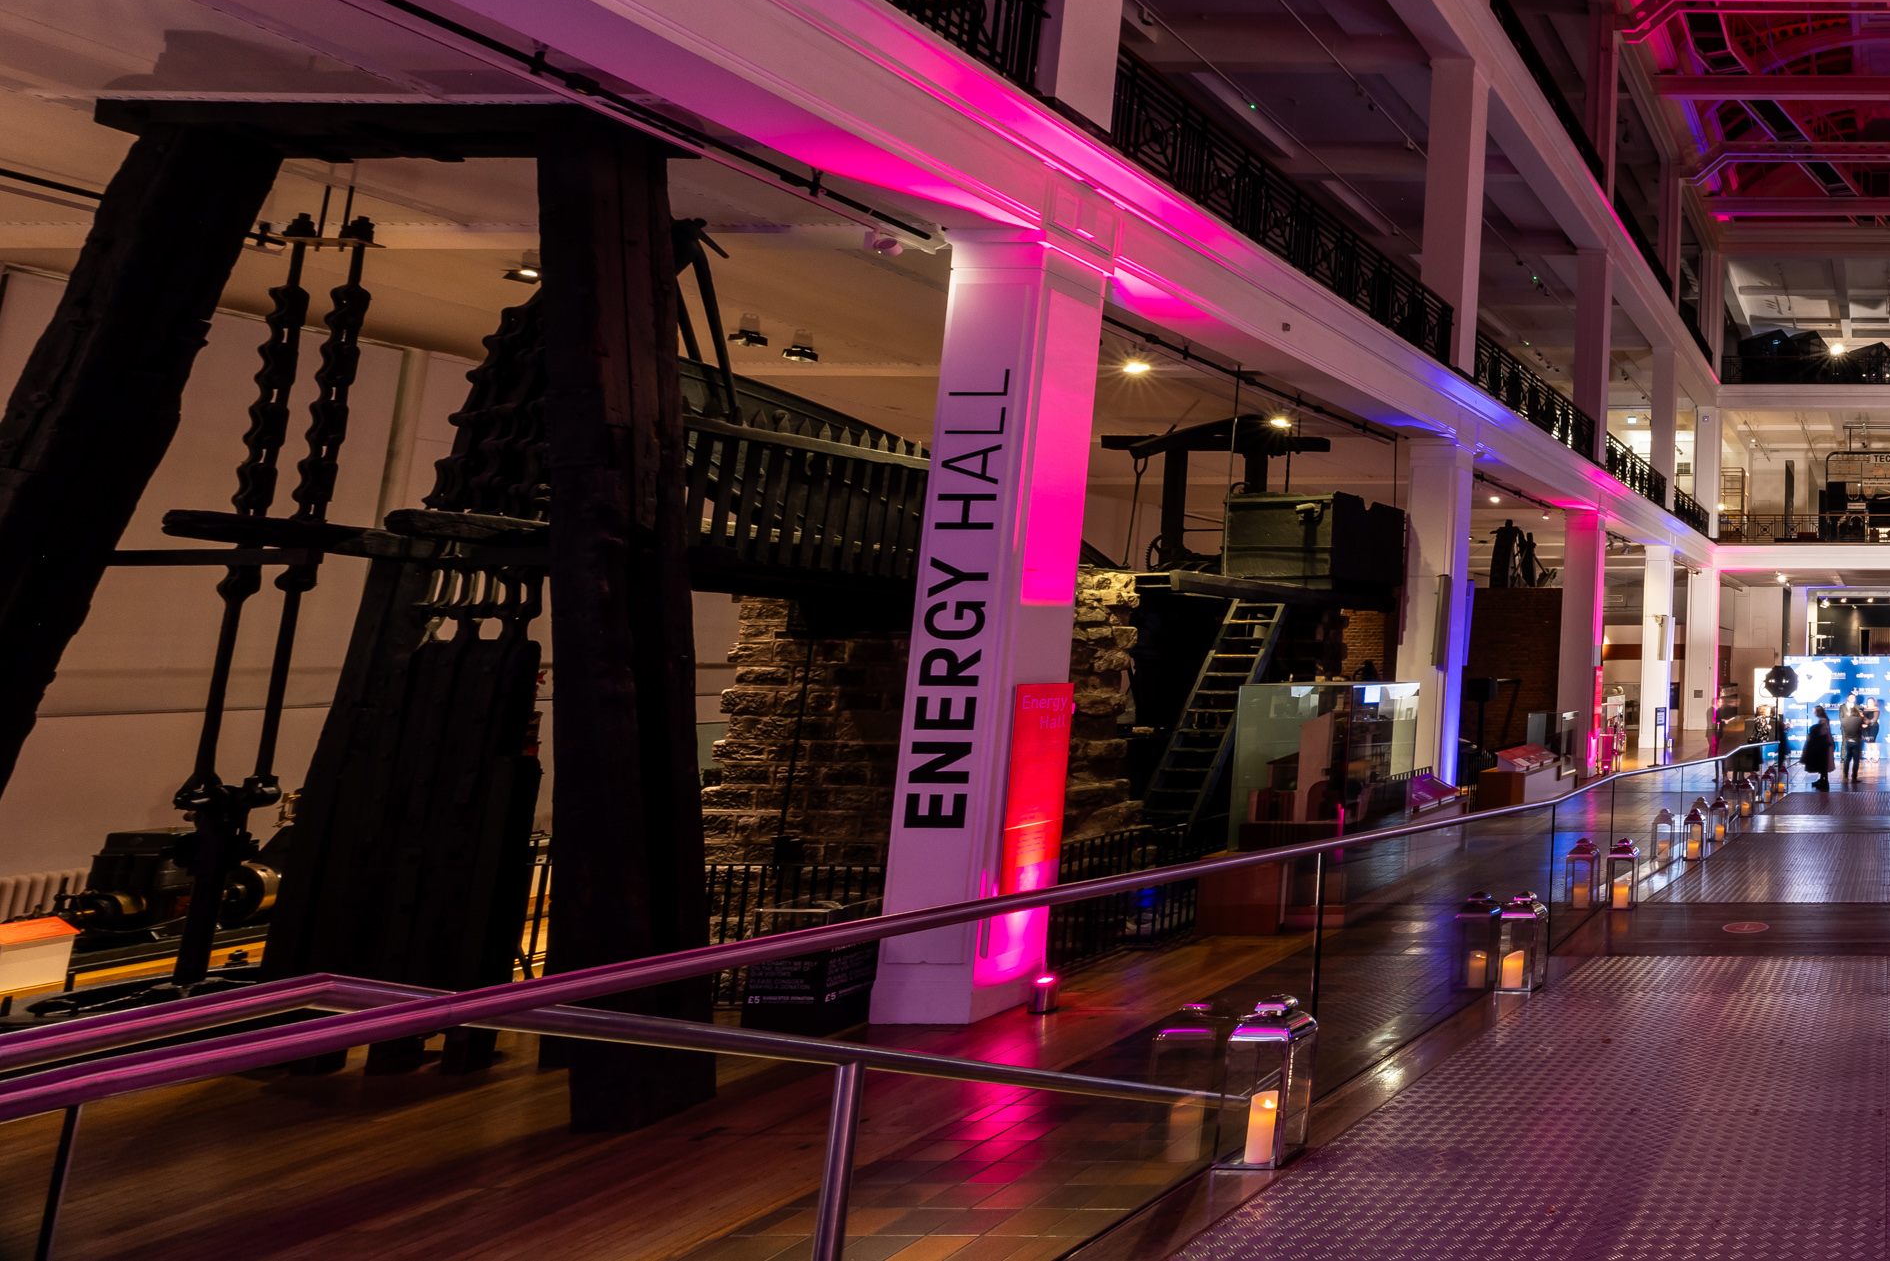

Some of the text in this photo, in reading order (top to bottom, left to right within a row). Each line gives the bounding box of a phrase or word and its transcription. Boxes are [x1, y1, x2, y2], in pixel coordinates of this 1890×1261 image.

[904, 368, 1010, 828] ENERGY HALL
[1022, 695, 1068, 712] Energy
[1039, 714, 1066, 729] Hall
[747, 995, 761, 1004] £5
[825, 991, 836, 1003] £5
